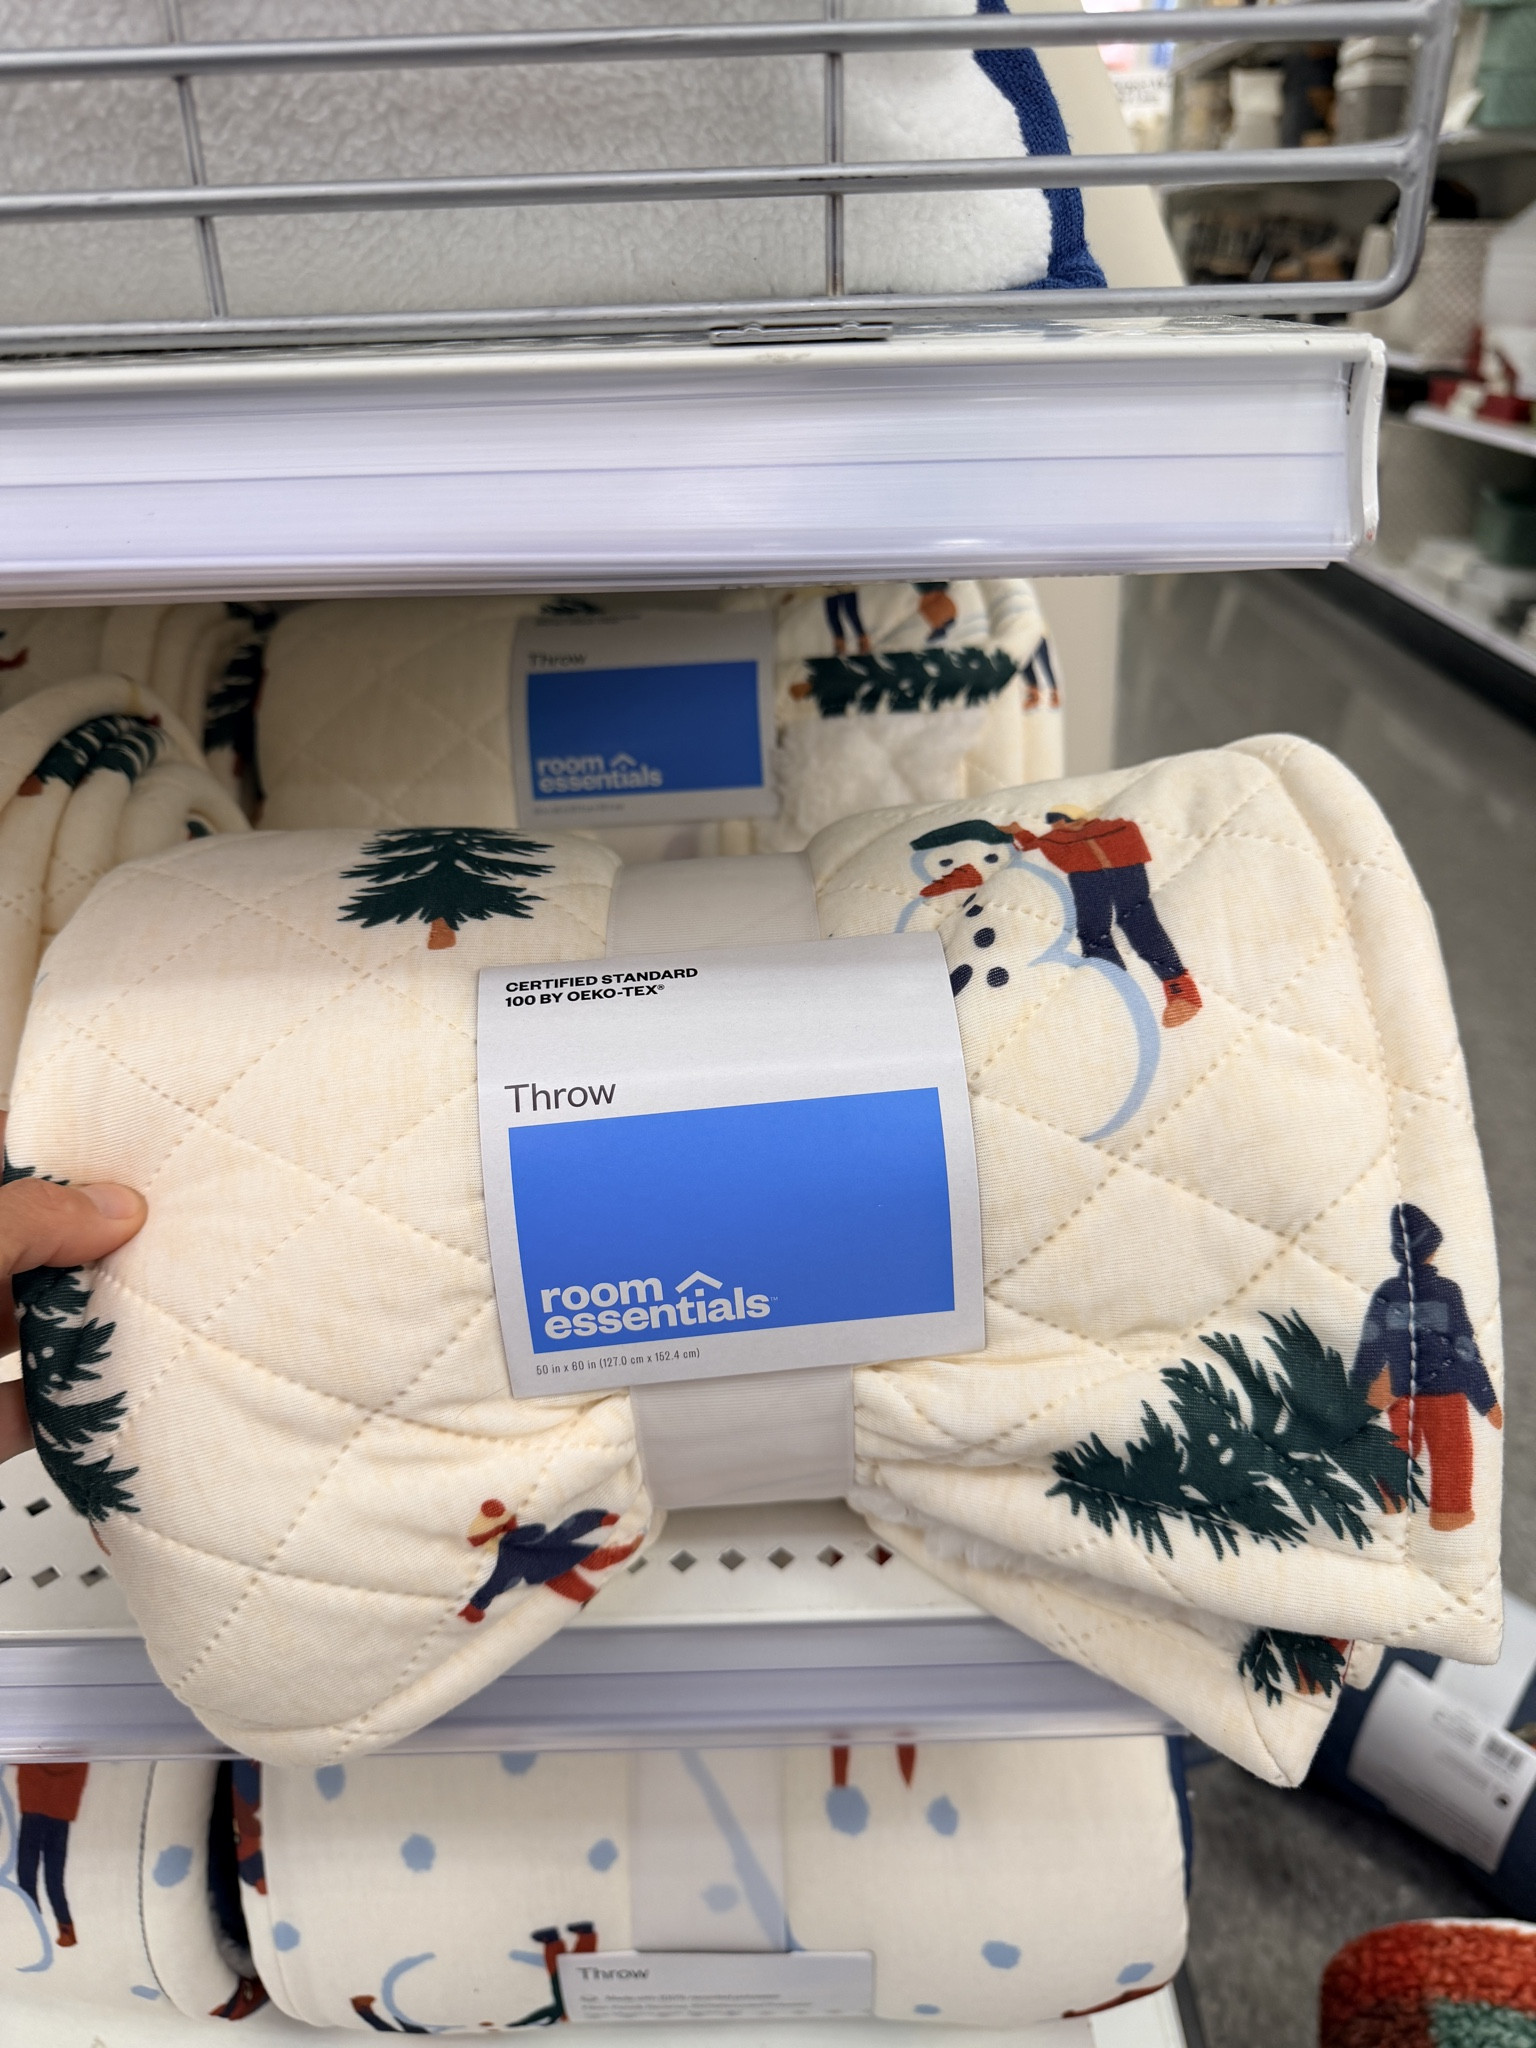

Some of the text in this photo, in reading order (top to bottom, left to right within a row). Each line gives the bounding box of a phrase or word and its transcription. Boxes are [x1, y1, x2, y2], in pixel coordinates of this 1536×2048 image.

[536, 756, 605, 776] room
[538, 764, 663, 794] essentials
[505, 967, 698, 992] CERTIFIED STANDARD
[505, 995, 536, 1007] 100
[540, 993, 563, 1004] BY
[505, 1083, 617, 1113] Throw
[541, 1277, 664, 1313] room
[536, 1364, 549, 1376] 50
[552, 1363, 561, 1374] in
[572, 1360, 585, 1371] 60
[588, 1359, 597, 1370] in
[599, 1356, 627, 1369] (127.0
[630, 1356, 644, 1365] cm
[647, 1355, 653, 1363] x
[655, 1350, 680, 1362] 152.4
[683, 1347, 700, 1359] cm)
[577, 1967, 649, 1981] Throw
